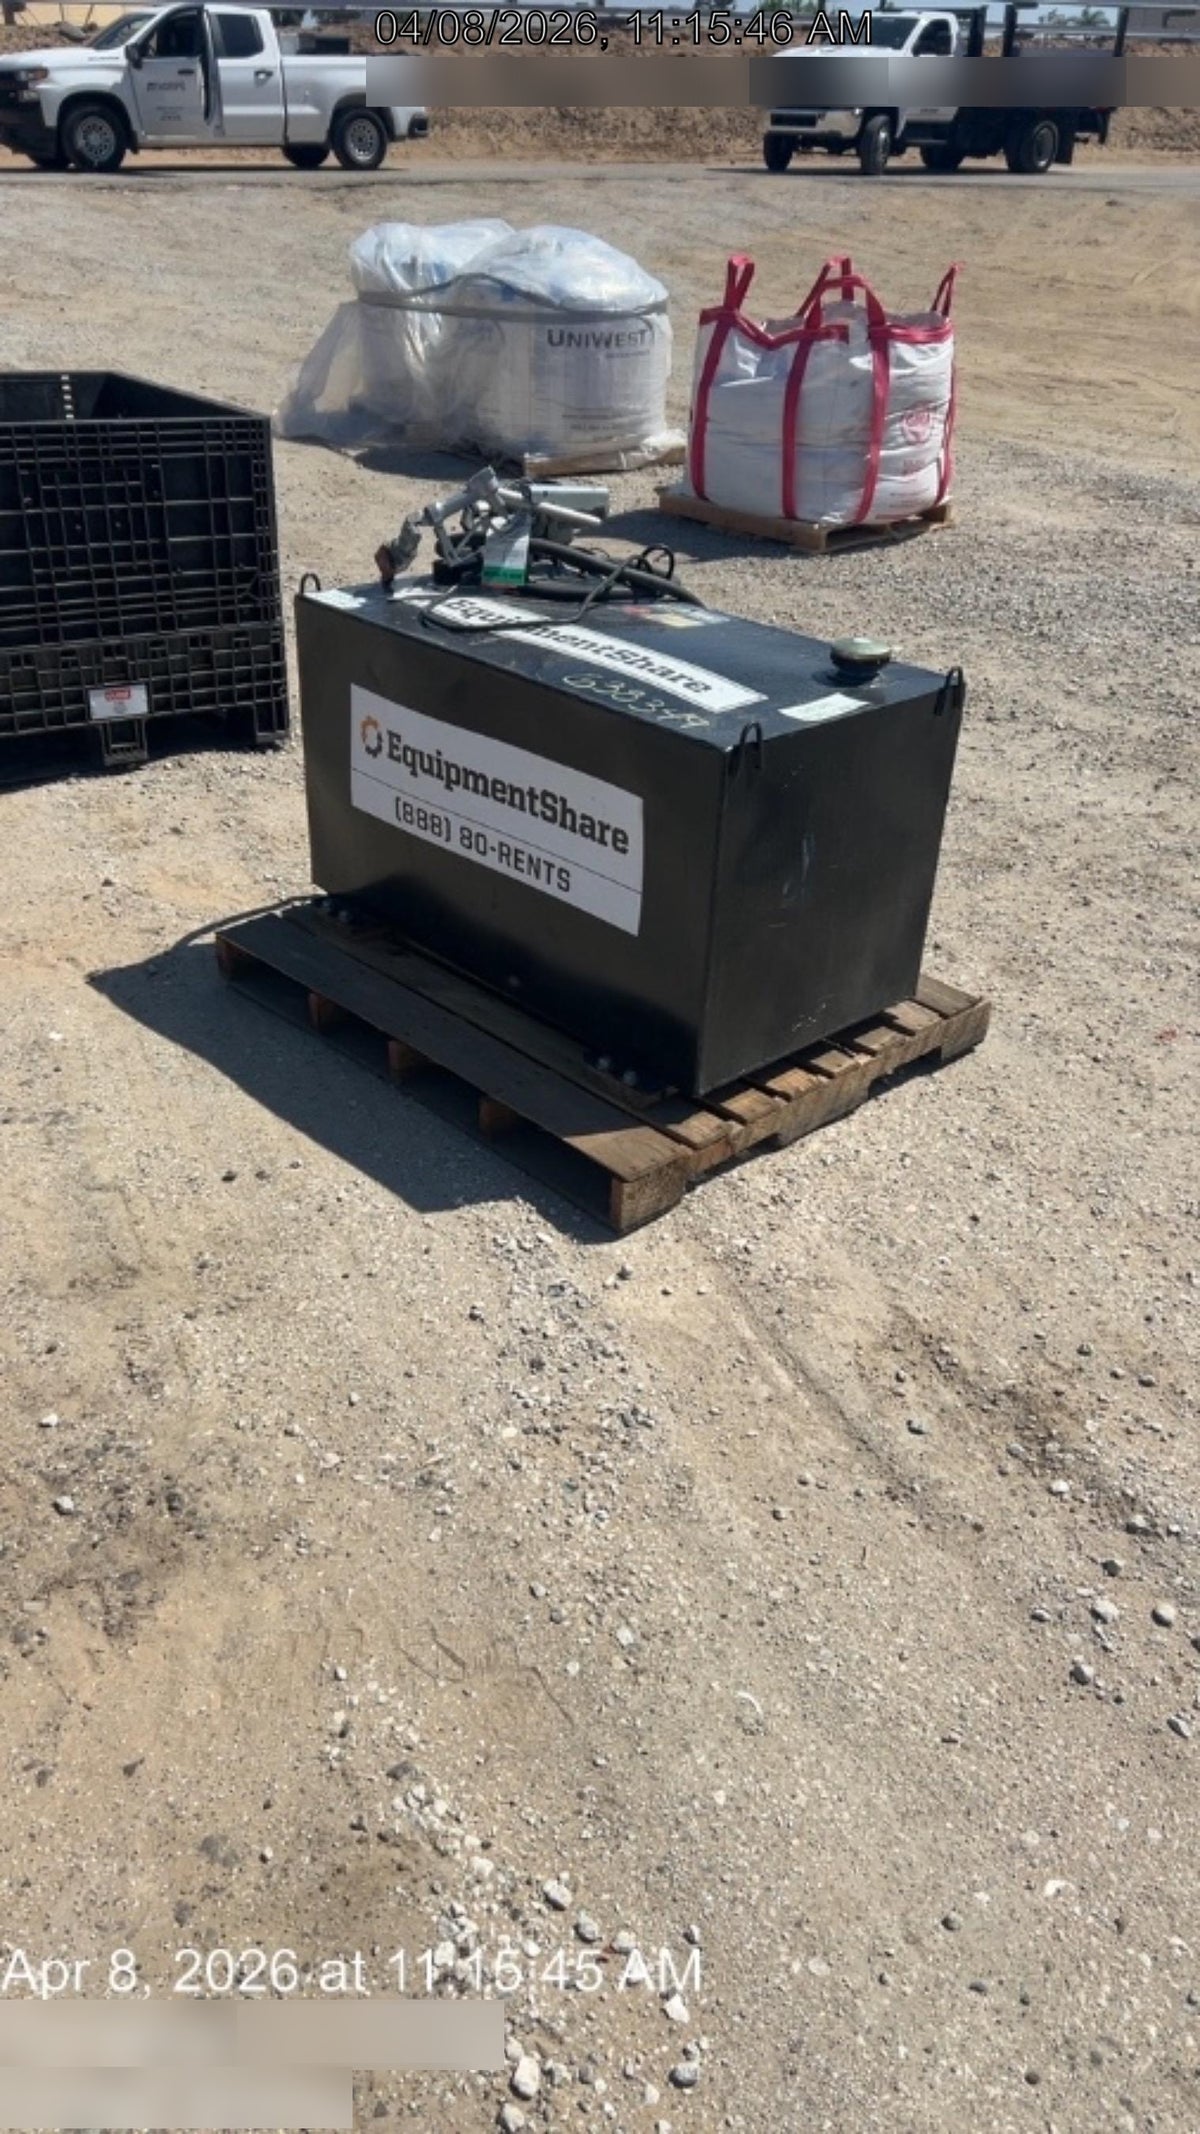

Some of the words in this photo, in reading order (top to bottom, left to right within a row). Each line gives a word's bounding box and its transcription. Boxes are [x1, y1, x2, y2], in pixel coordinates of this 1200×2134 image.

[444, 599, 712, 692] EquimentShare
[387, 730, 629, 854] EquipmentShare
[395, 796, 451, 843] (888)
[459, 827, 570, 892] 80-RENTS
